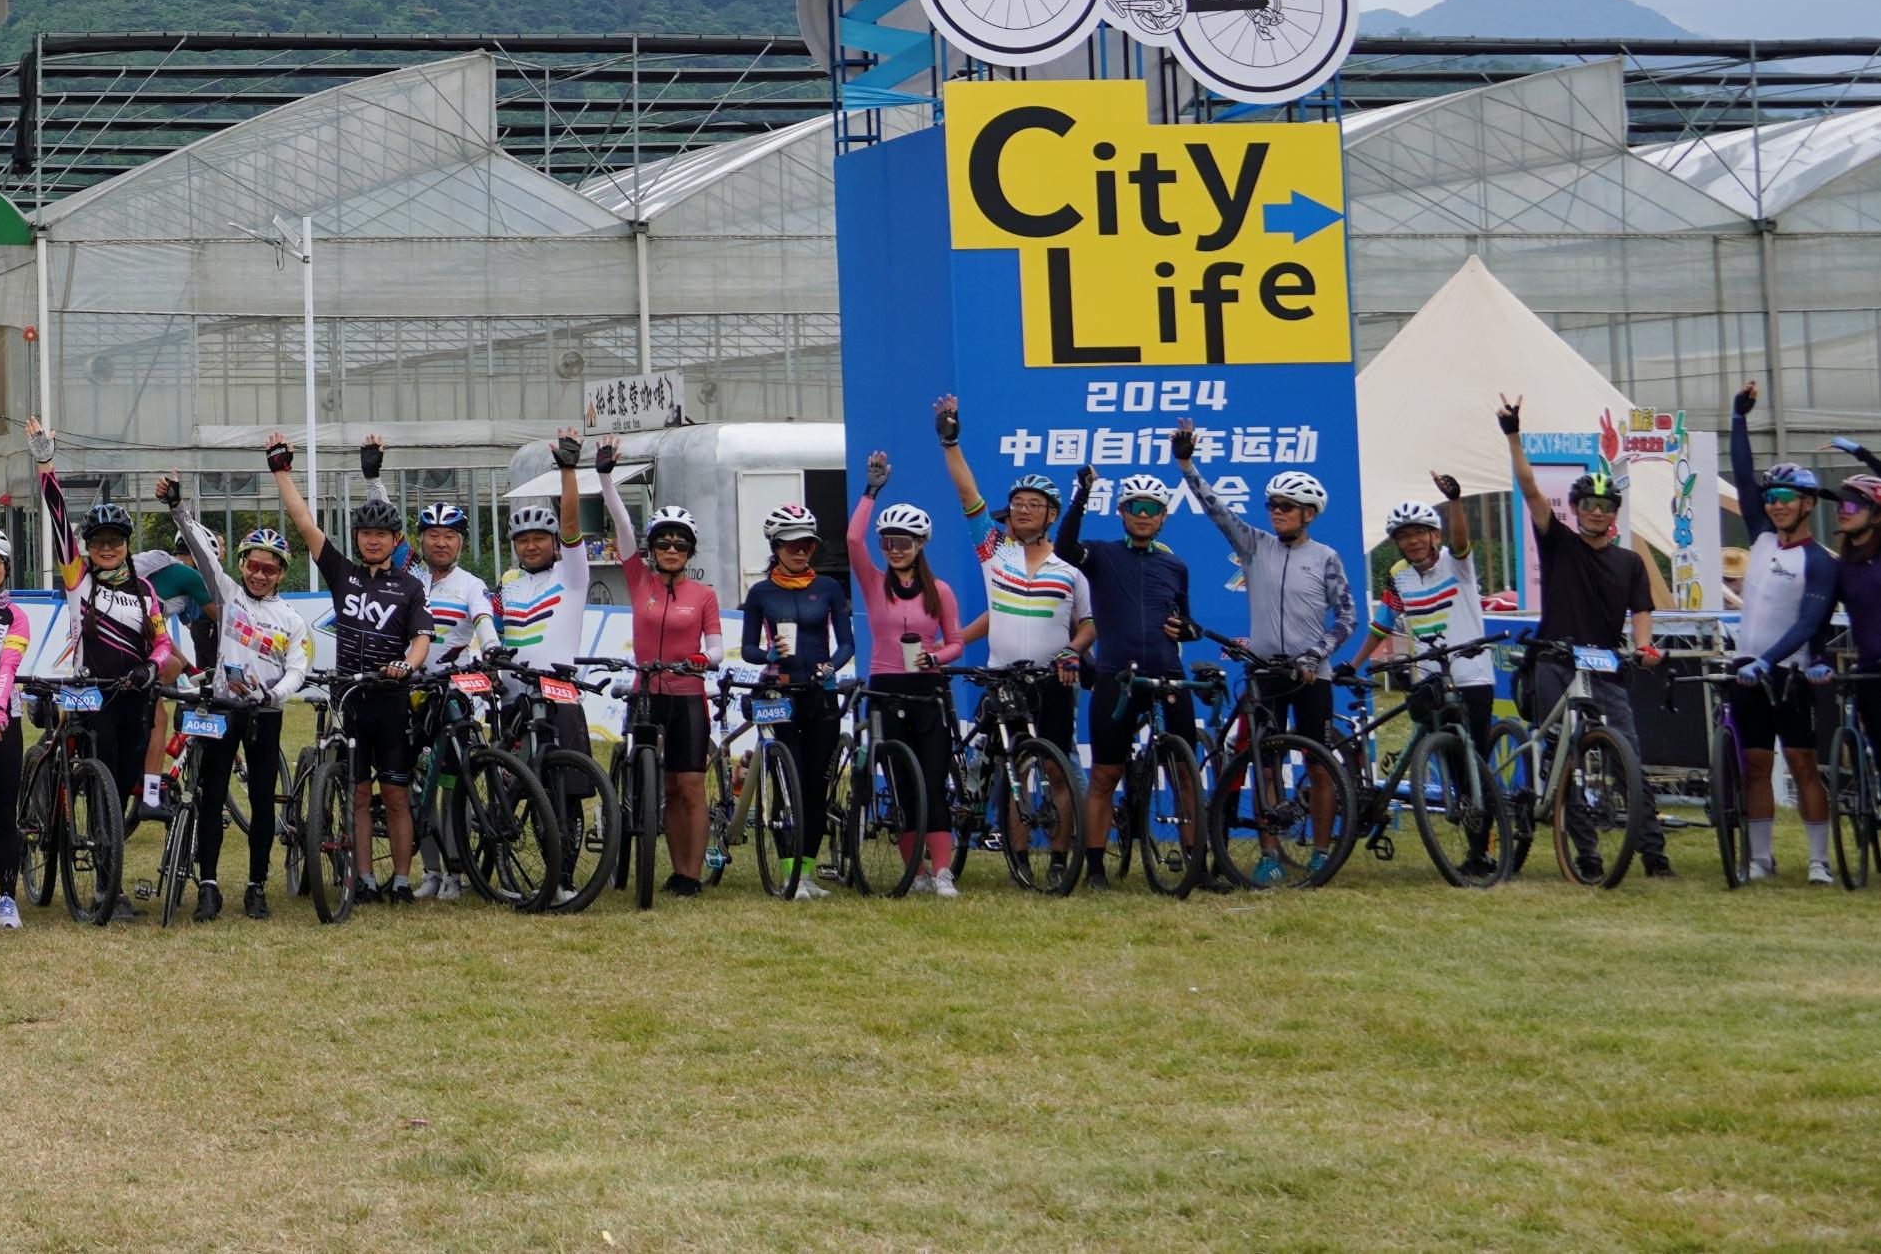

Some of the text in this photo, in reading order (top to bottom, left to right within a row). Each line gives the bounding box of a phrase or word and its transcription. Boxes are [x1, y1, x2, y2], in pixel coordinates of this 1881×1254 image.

[968, 105, 1271, 253] City
[1046, 247, 1317, 365] Life
[1085, 380, 1229, 413] 2024
[999, 425, 1319, 467] 中国自行车运动
[342, 592, 398, 631] sky
[186, 720, 219, 733] A0491
[756, 707, 786, 719] A0495
